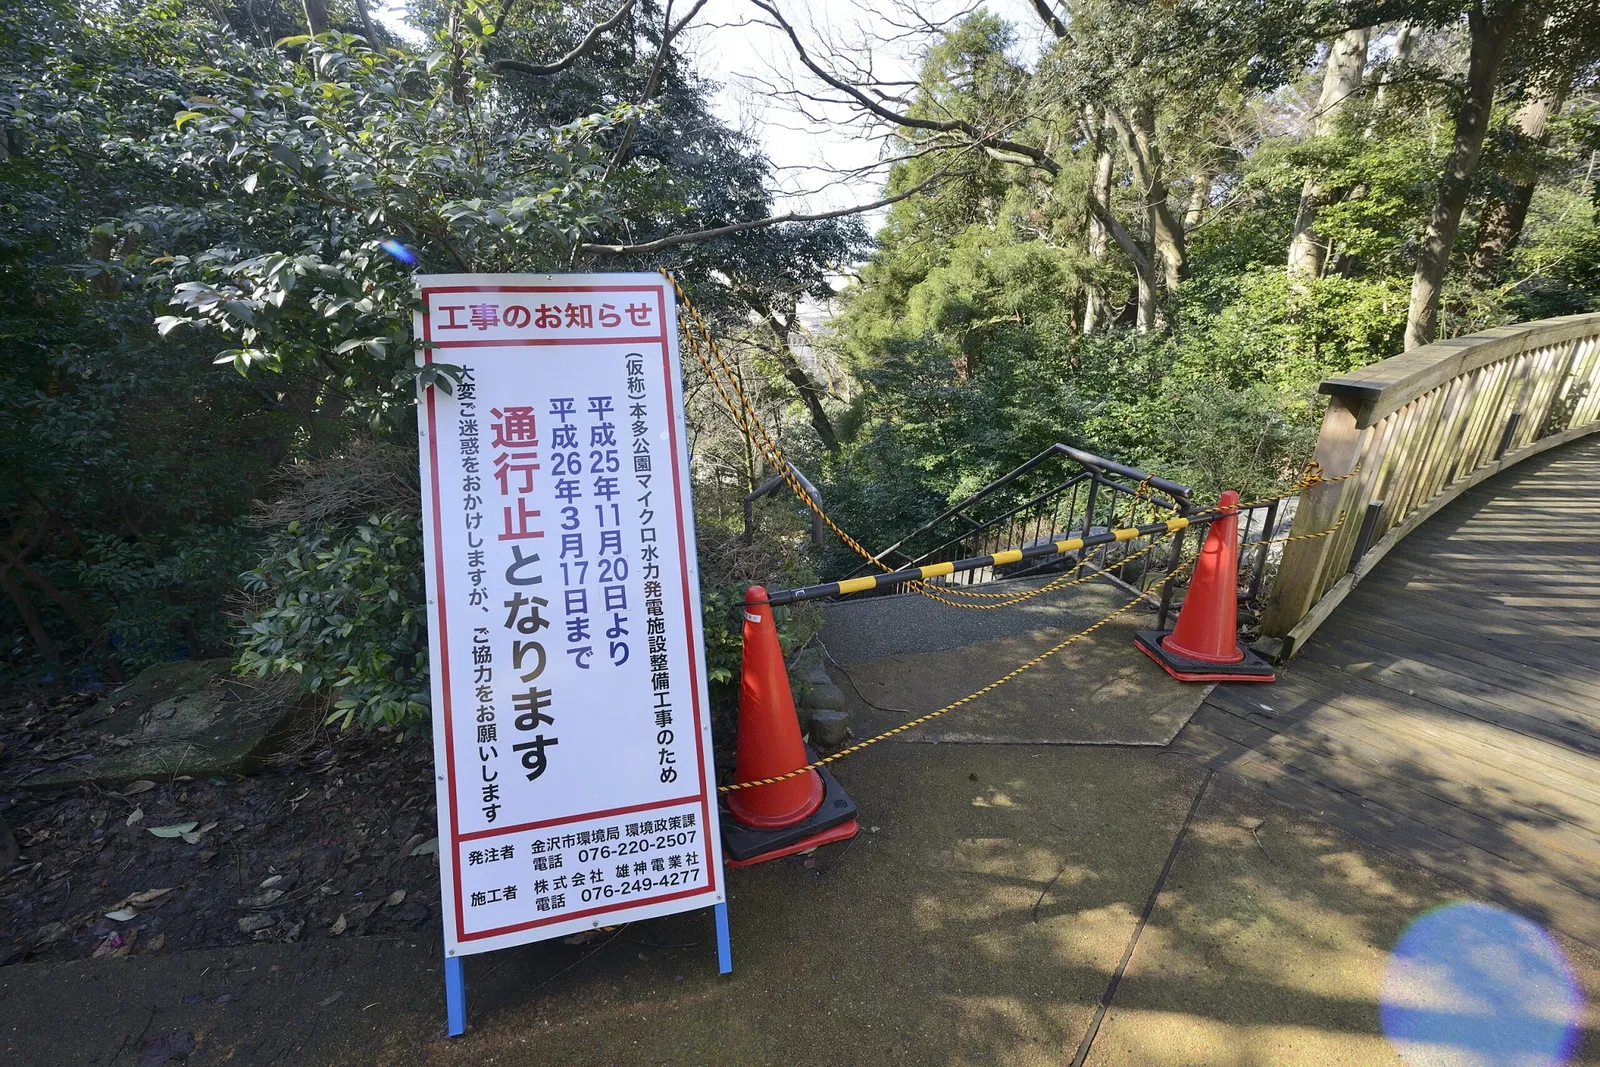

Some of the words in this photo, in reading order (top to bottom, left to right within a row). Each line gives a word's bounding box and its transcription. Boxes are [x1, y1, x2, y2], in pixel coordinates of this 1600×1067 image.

[437, 303, 652, 331] 工事のお知らせ
[549, 397, 594, 669] 平成26年3月17日まで
[588, 396, 629, 667] 平成25年11月20日より
[625, 353, 678, 784] （仮称）本多公園マイクロ水力発電施設整備工事のため
[490, 406, 559, 782] 通行止となります
[469, 845, 515, 867] 発注者
[532, 855, 563, 872] 電話
[578, 831, 697, 863] 076-220-2507
[470, 885, 518, 907] 施工者
[535, 894, 566, 912] 電話
[581, 868, 700, 902] 076-249-4277
